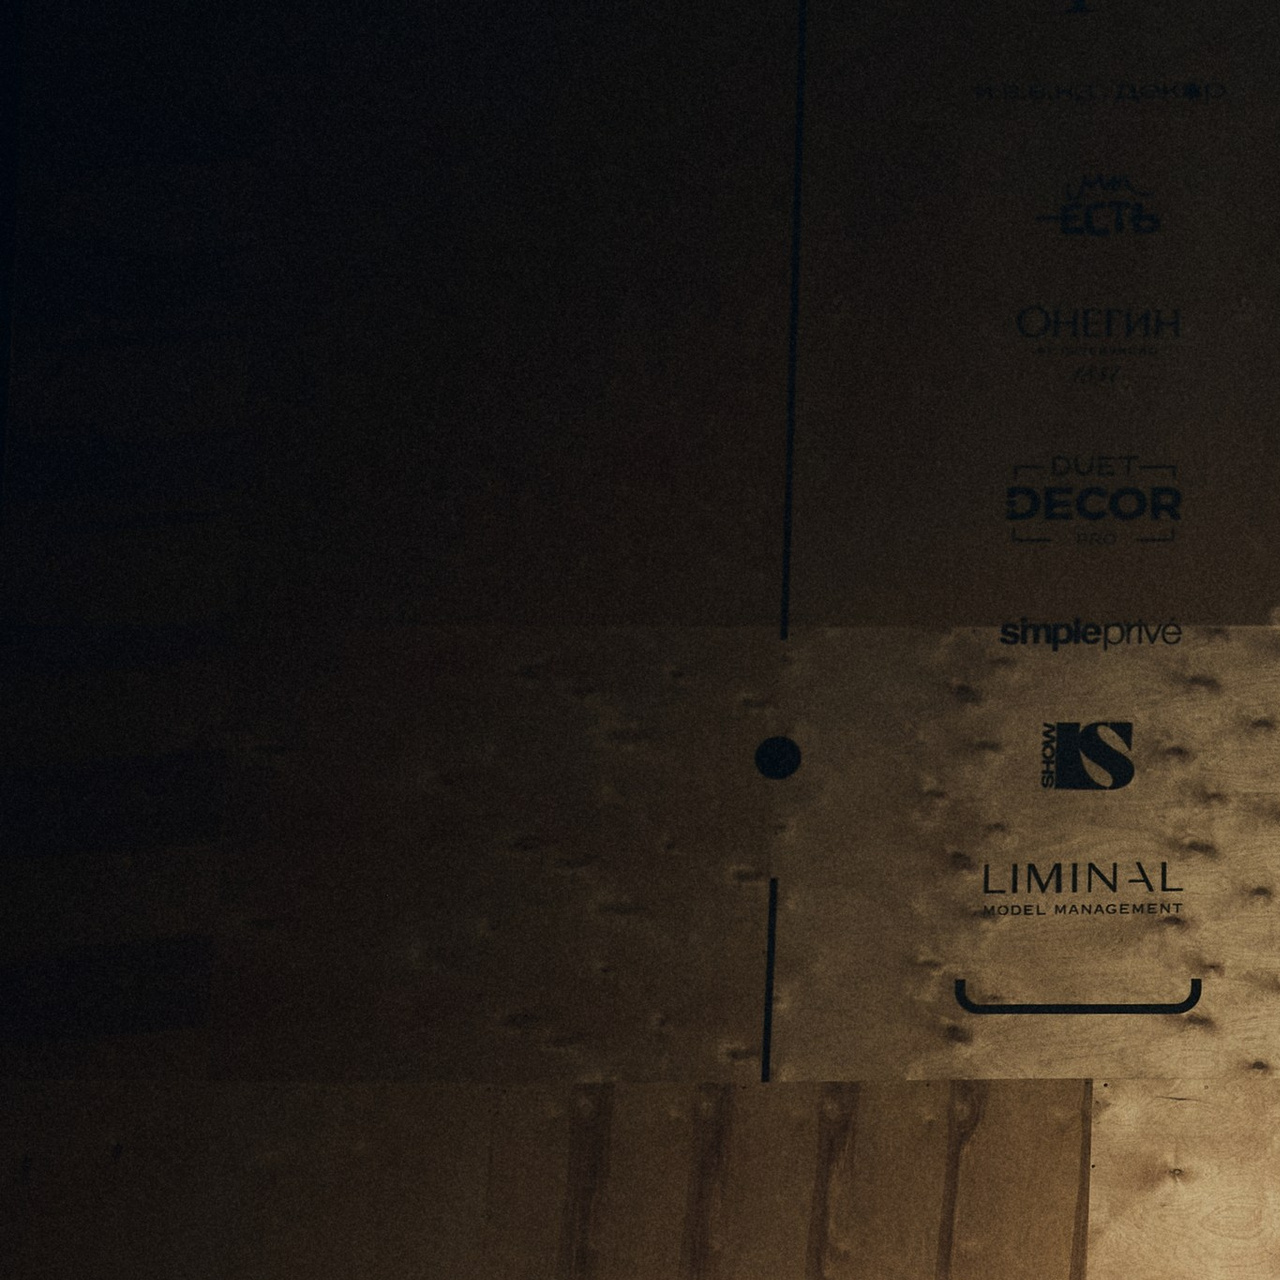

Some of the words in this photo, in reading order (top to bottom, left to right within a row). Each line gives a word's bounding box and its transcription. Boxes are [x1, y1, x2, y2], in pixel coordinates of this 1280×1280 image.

[1016, 304, 1180, 338] ОНЕГИН
[1051, 455, 1138, 477] DUET
[1006, 487, 1182, 521] DECOR
[983, 862, 1183, 894] LIMINAL
[983, 904, 1046, 916] MODEL
[1054, 903, 1183, 915] MANAGEMENT
